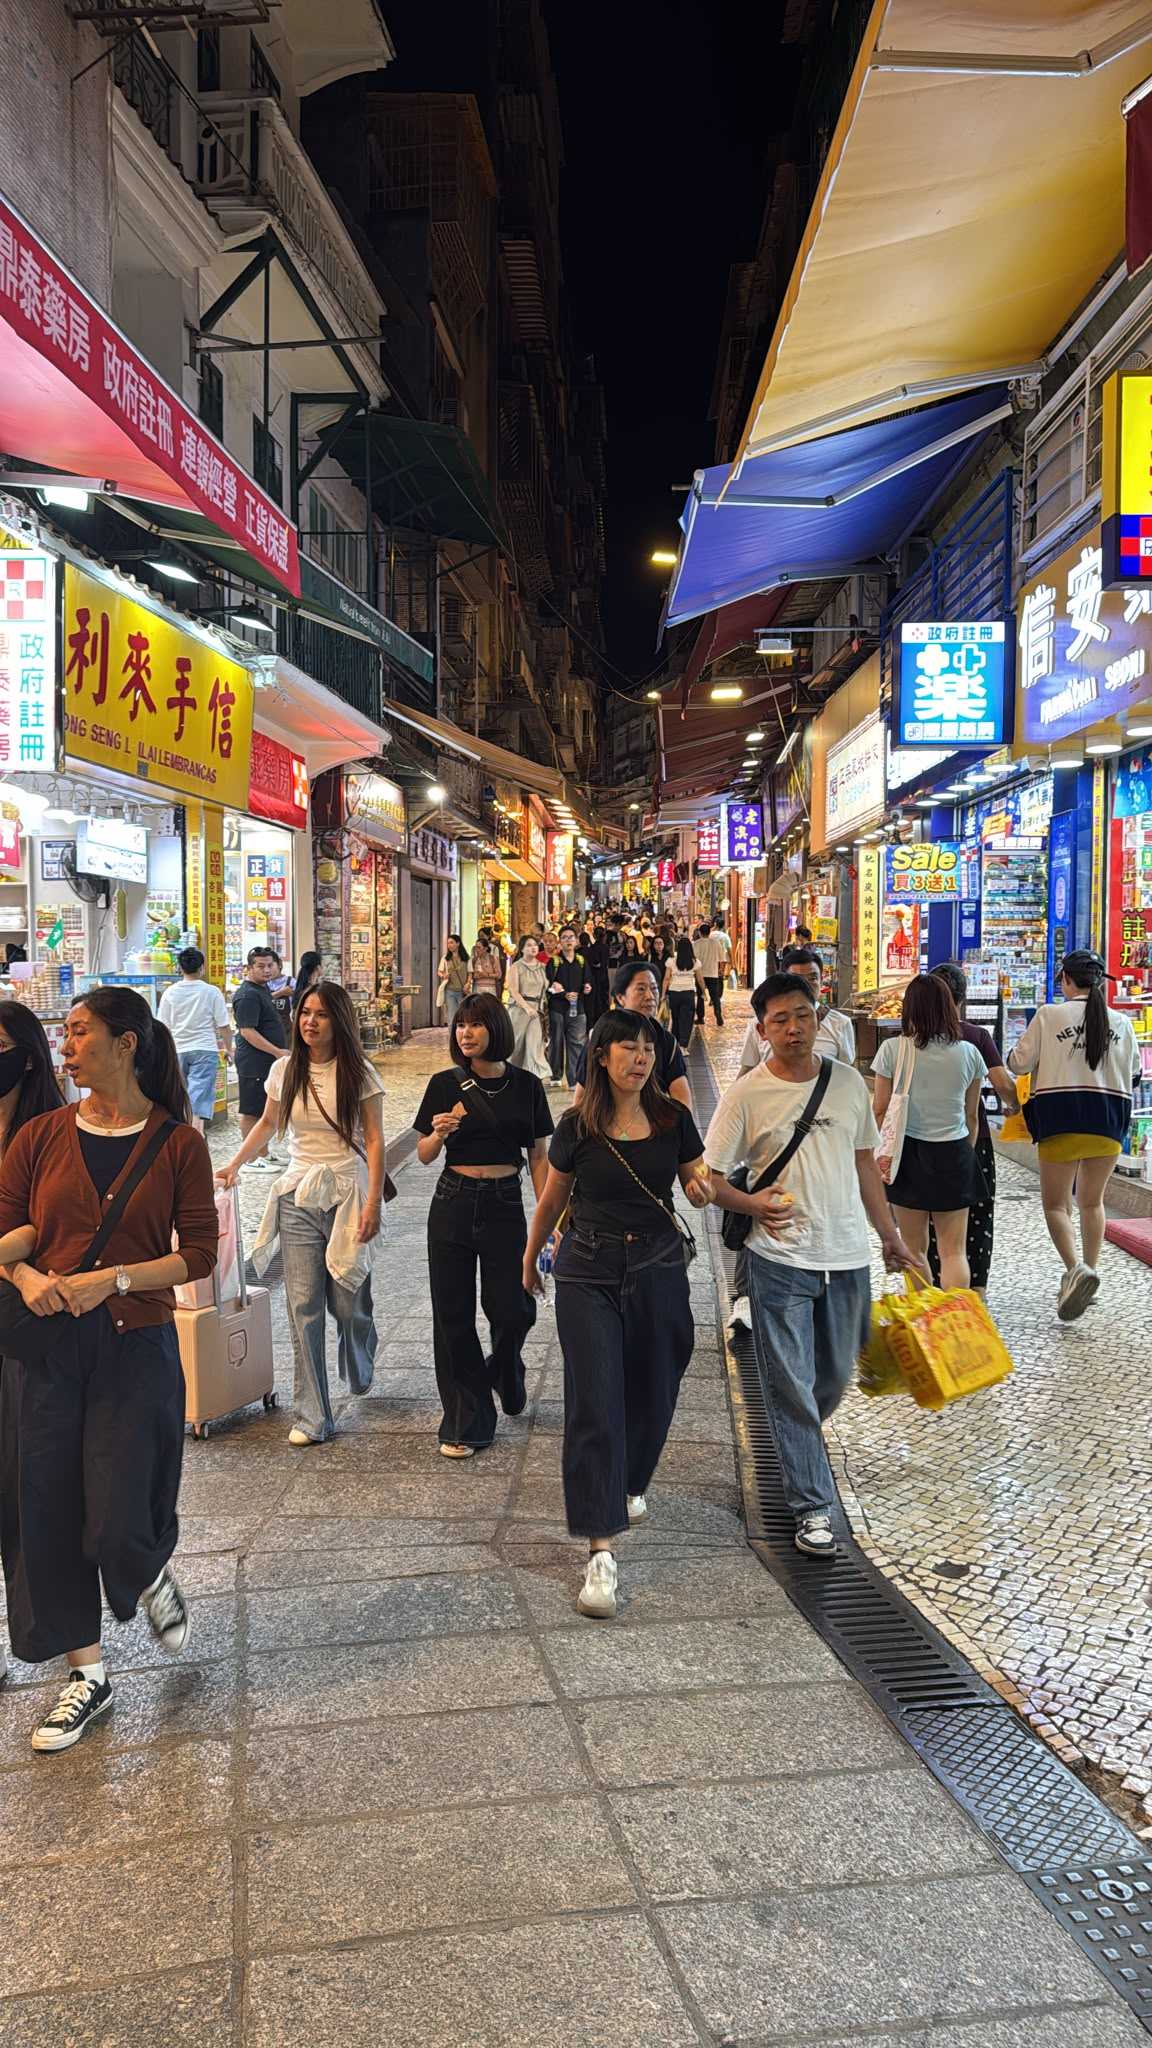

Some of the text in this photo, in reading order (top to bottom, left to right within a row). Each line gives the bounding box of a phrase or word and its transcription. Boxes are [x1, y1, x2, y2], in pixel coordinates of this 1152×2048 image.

[103, 336, 174, 459] 政府註冊
[928, 626, 994, 642] 政府註冊
[66, 607, 236, 759] 利來手信
[19, 633, 45, 762] 政府註冊
[91, 724, 122, 750] SENG
[250, 858, 284, 876] 正貨
[892, 845, 957, 872] Sale
[250, 881, 284, 898] 保證
[1056, 1024, 1085, 1042] NEW
